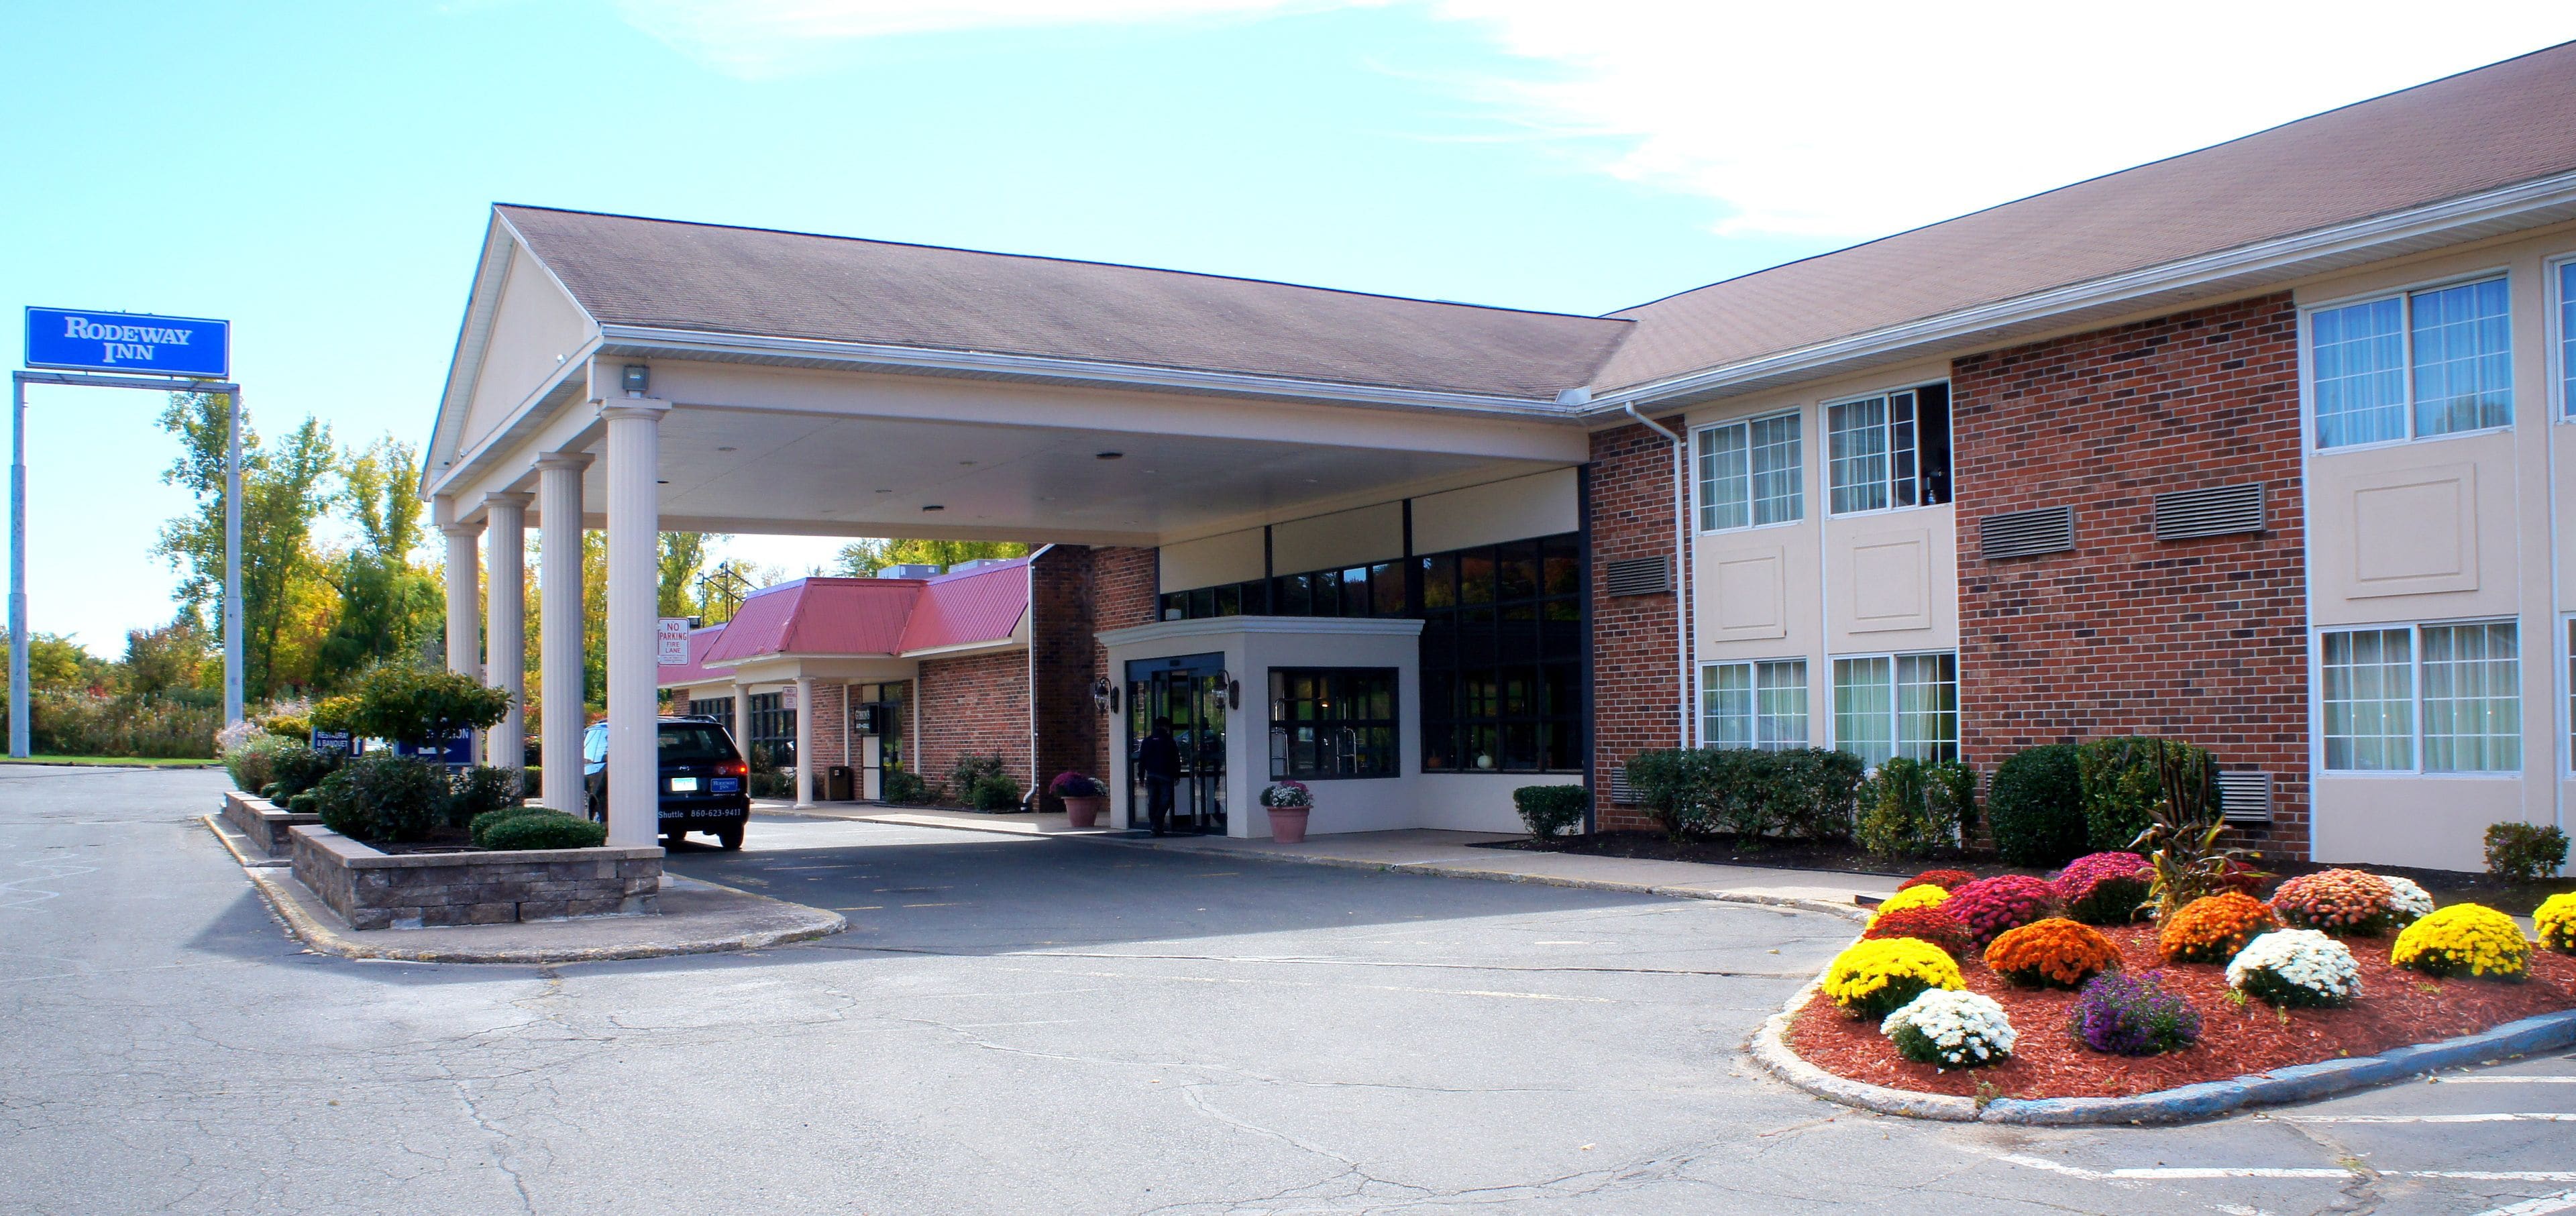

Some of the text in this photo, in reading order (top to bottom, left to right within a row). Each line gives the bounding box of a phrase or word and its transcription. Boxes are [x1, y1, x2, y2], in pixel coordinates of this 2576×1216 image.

[64, 317, 193, 345] RODEWAY
[103, 342, 155, 364] INN
[691, 809, 741, 817] 860-623-9411
